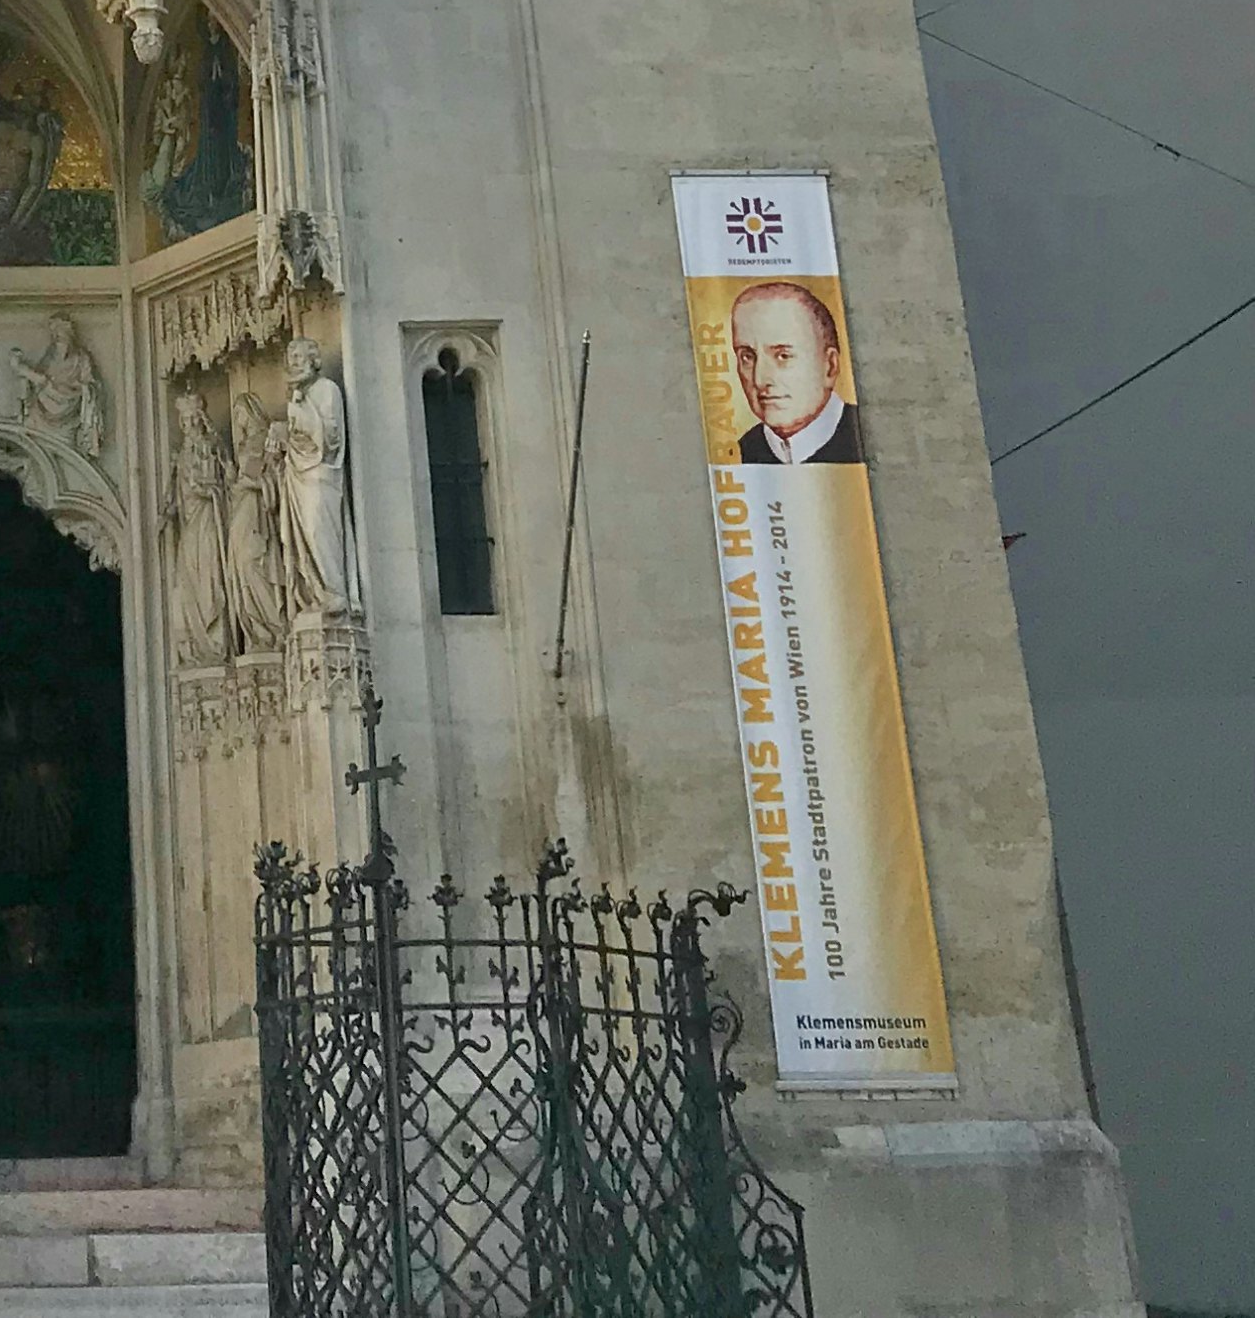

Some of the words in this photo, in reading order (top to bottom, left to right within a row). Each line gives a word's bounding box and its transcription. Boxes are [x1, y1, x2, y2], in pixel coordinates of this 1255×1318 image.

[696, 322, 754, 557] HOFBAUER
[768, 500, 789, 549] 2014
[777, 570, 797, 618] 1914
[728, 571, 774, 724] MARIA
[786, 625, 805, 679] Wien
[793, 684, 812, 723] von
[800, 728, 830, 862] Stadtpatron
[748, 740, 806, 981] KLEMENS
[817, 867, 840, 933] Jahre
[825, 939, 846, 980] 100
[796, 1015, 927, 1030] Klemensmuseum
[799, 1036, 812, 1050] in
[814, 1036, 852, 1050] Maria
[854, 1039, 875, 1050] am
[877, 1036, 929, 1050] Gestade
